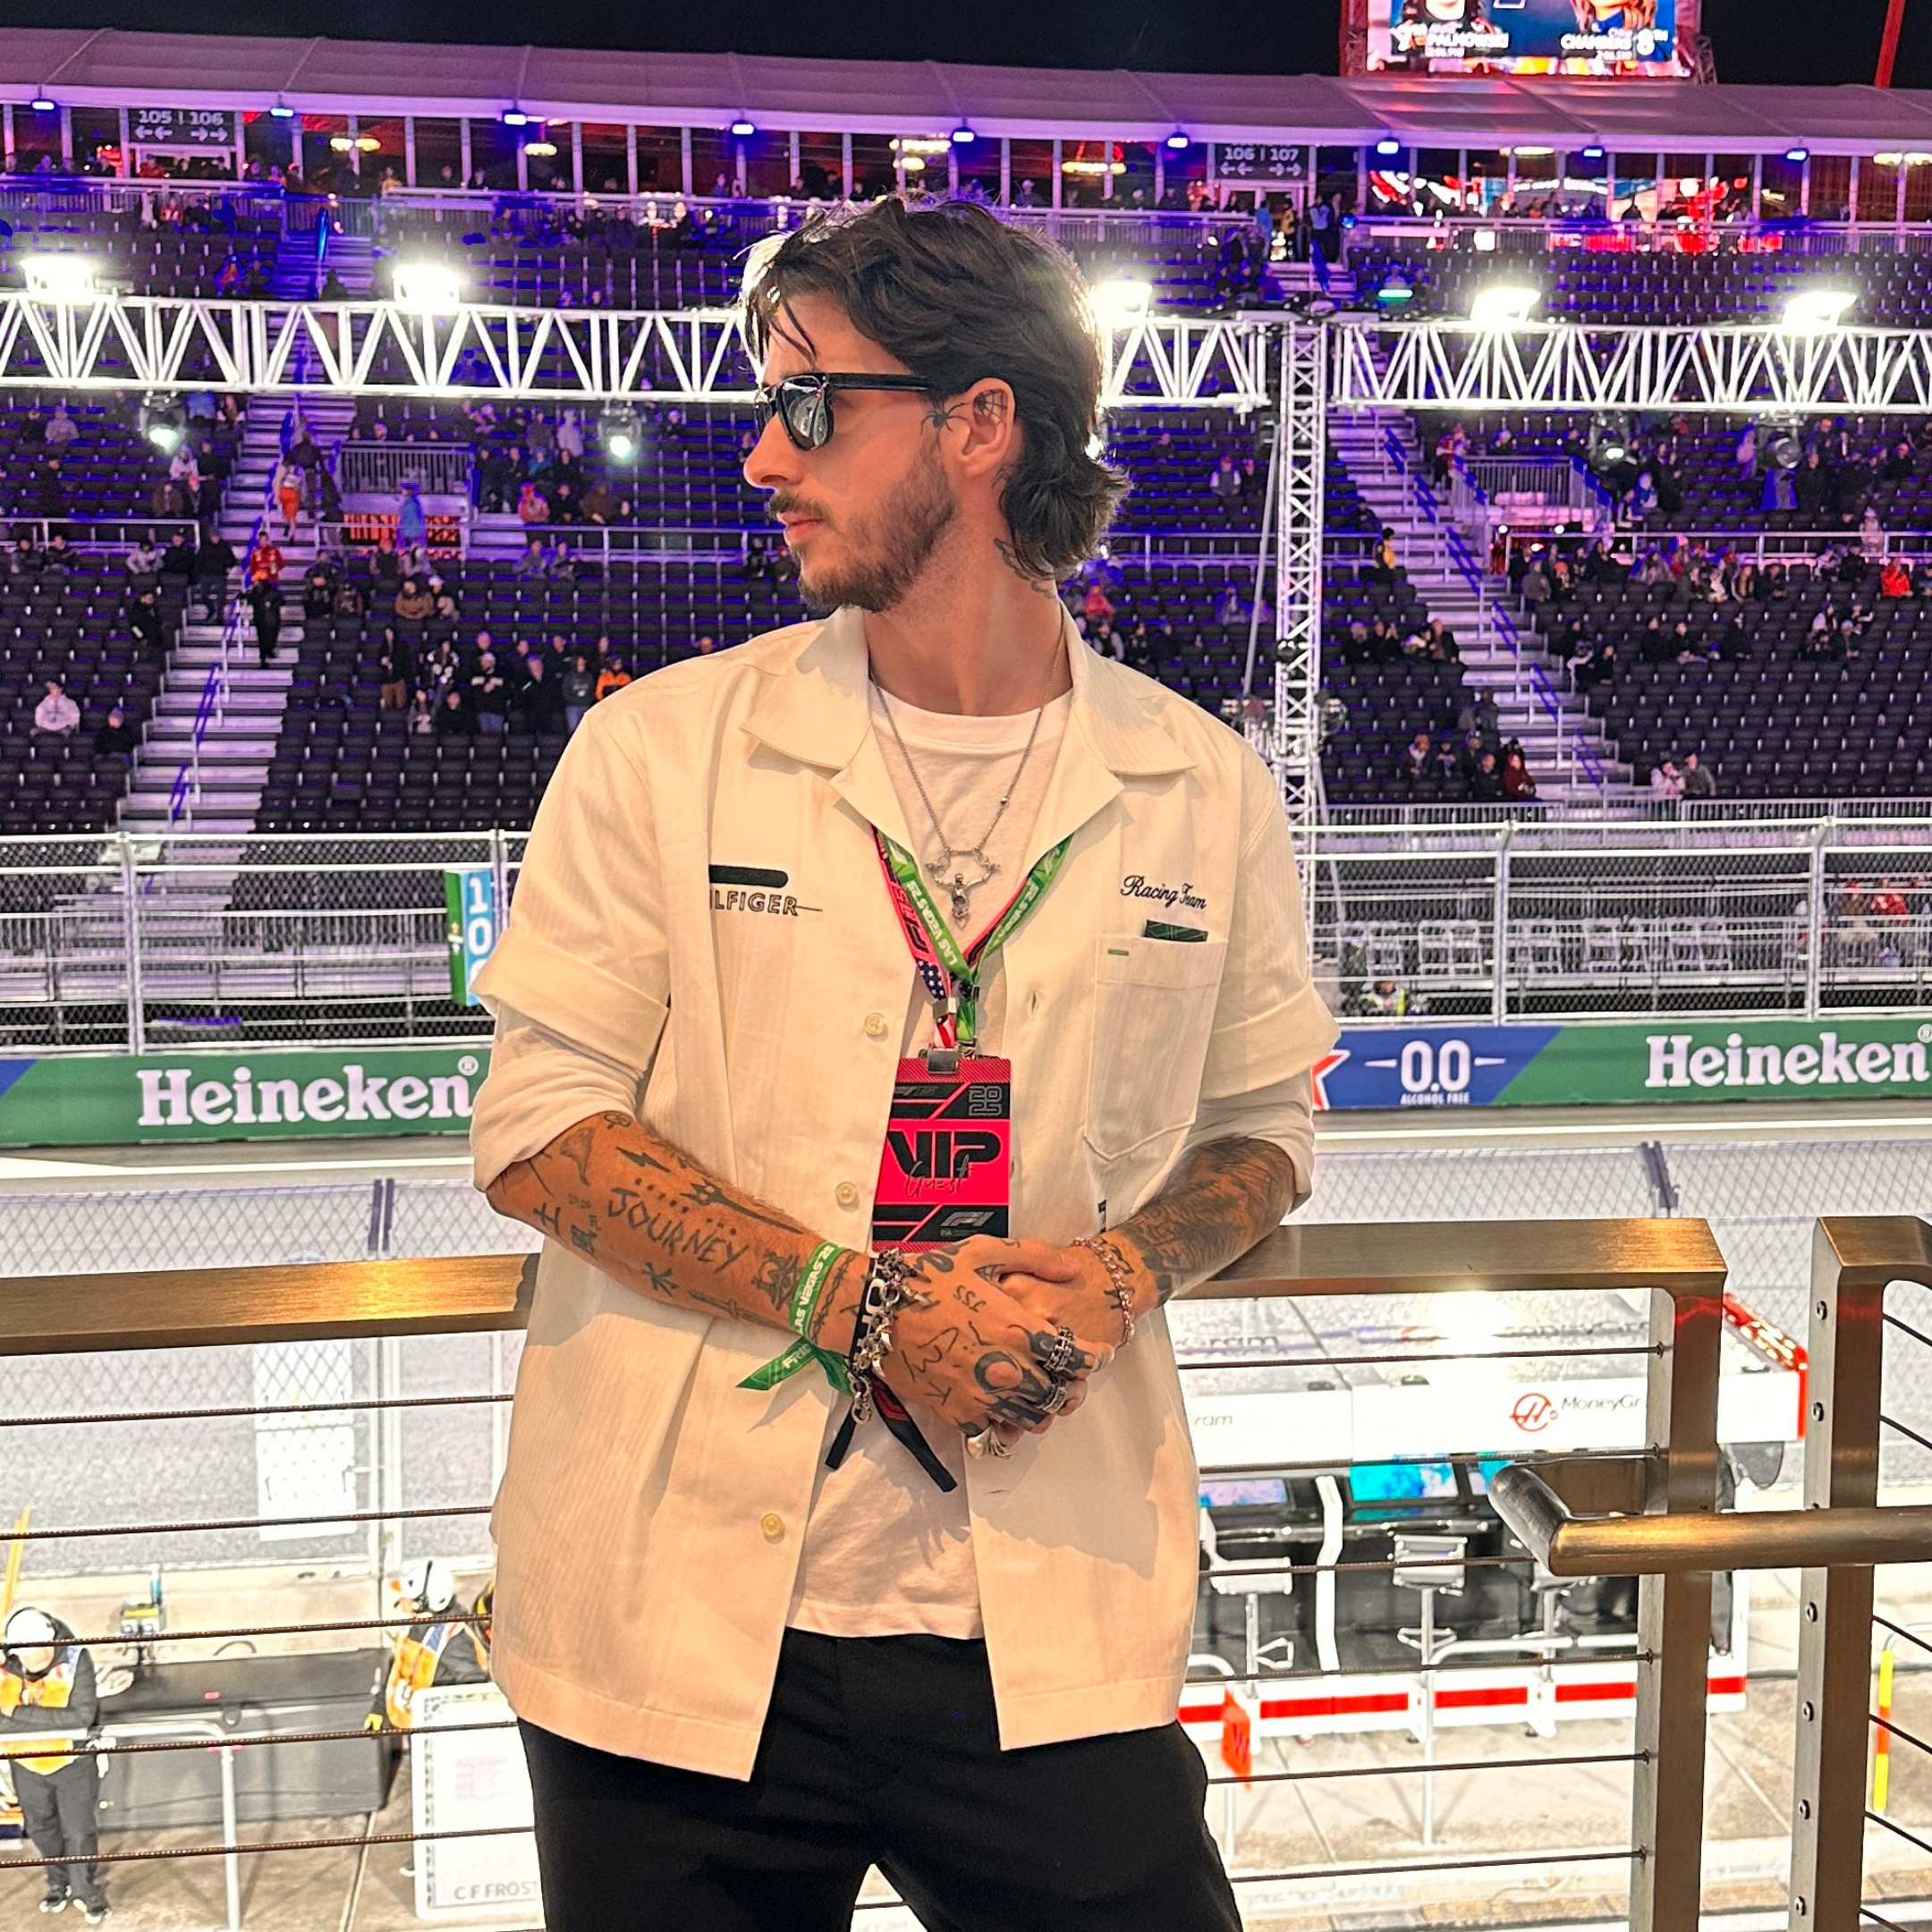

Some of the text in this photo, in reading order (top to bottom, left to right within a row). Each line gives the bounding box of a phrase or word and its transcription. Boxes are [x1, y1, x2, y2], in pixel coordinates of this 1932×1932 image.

[139, 110, 224, 125] 105 106
[1224, 148, 1299, 161] 106 107
[709, 889, 799, 916] LFIGER
[1120, 875, 1208, 910] Racing Team
[1401, 1039, 1470, 1093] 0.0
[1645, 1031, 1930, 1088] Heineken
[137, 1065, 474, 1126] Heineken
[1401, 1092, 1470, 1105] ALCOHOL FREE
[886, 1131, 1001, 1179] VIP
[608, 1186, 749, 1275] JOURNEY
[1562, 1394, 1642, 1411] MoneyGr
